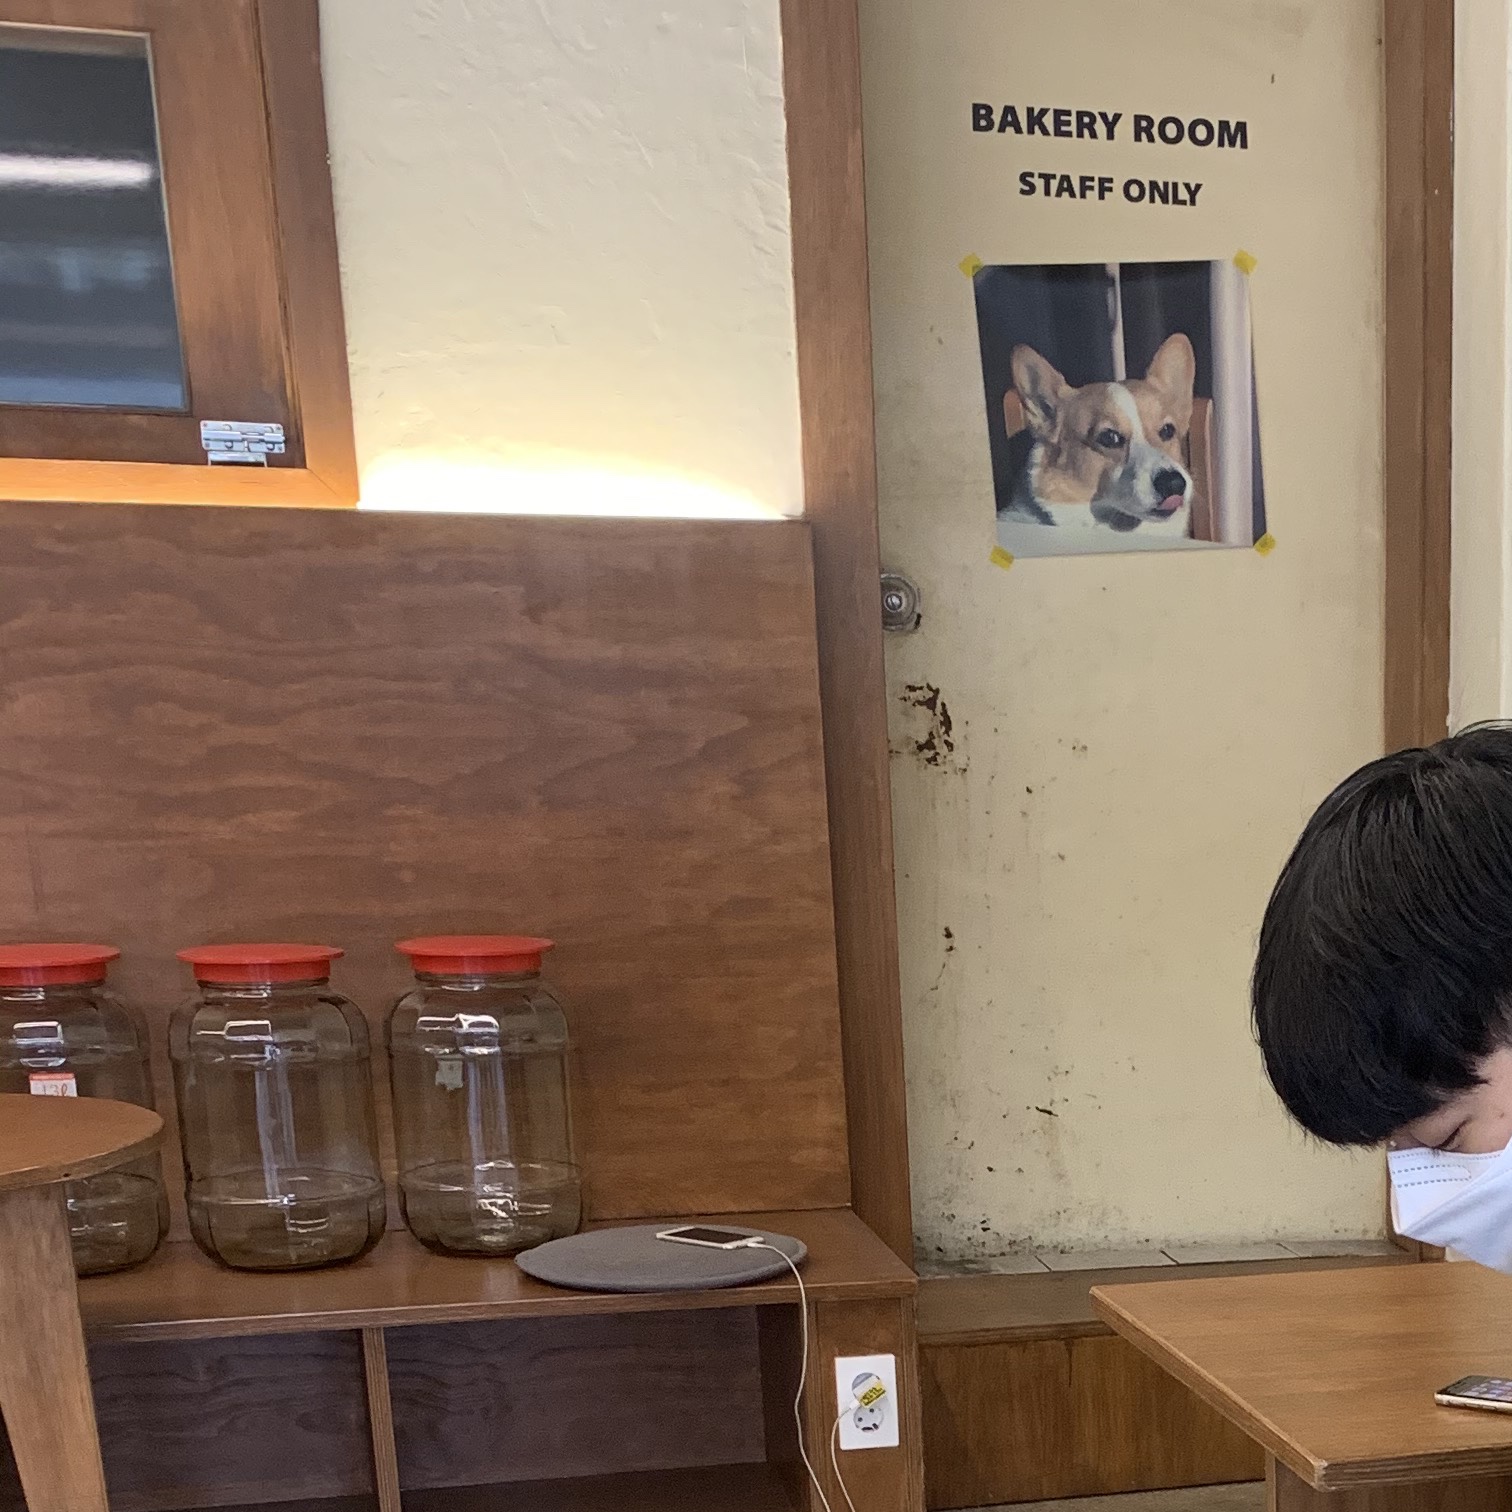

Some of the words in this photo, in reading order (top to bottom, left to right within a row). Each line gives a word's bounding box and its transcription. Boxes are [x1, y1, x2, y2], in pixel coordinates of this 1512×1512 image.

[971, 102, 1123, 141] BAKERY
[1133, 113, 1249, 150] ROOM
[1018, 171, 1114, 201] STAFF
[1122, 178, 1203, 207] ONLY
